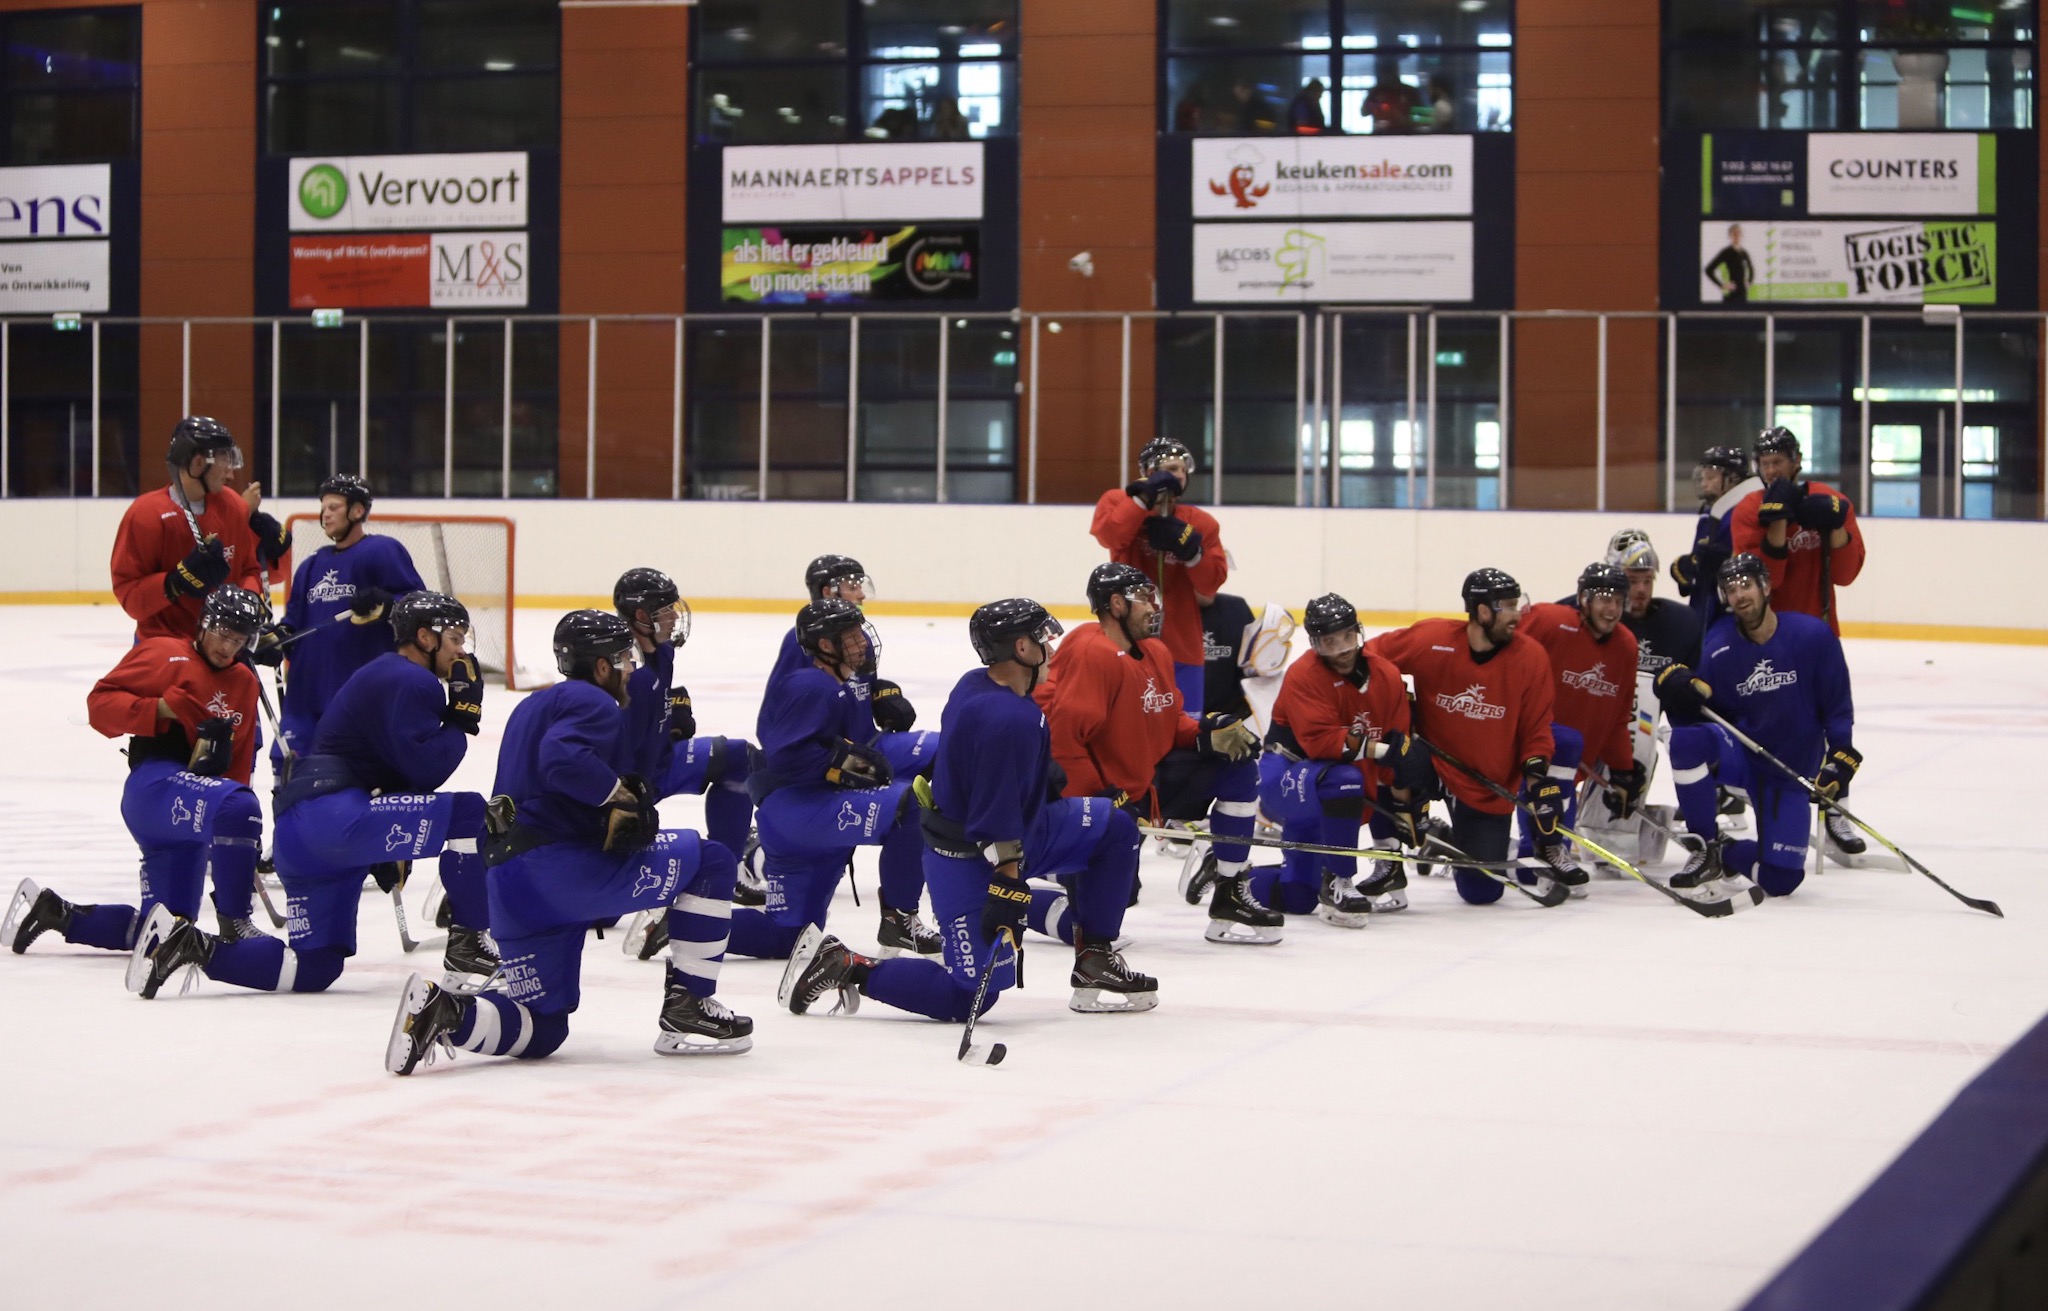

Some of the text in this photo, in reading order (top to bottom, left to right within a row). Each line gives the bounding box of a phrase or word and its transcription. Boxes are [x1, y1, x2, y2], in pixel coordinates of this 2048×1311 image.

[730, 167, 975, 188] MANNAERTSAPPELS
[1276, 159, 1453, 179] keukensale.com
[1829, 160, 1958, 178] COUNTERS
[359, 169, 519, 205] Vervoort
[734, 237, 888, 266] als het er gekleurd
[1851, 224, 1978, 263] LOGISTIC
[434, 239, 522, 289] M&S
[1216, 249, 1270, 262] JACOBS
[1854, 249, 1983, 294] FORCE
[12, 278, 90, 291] Ontwikkeling
[750, 272, 871, 295] op moet staan
[1562, 669, 1619, 696] TRAPPERS
[1436, 692, 1506, 720] TRAPPERS
[369, 794, 436, 806] RICORP
[655, 833, 678, 844] RP
[988, 883, 1032, 905] BAUER
[287, 904, 300, 919] KET
[1102, 971, 1123, 983] CCM
